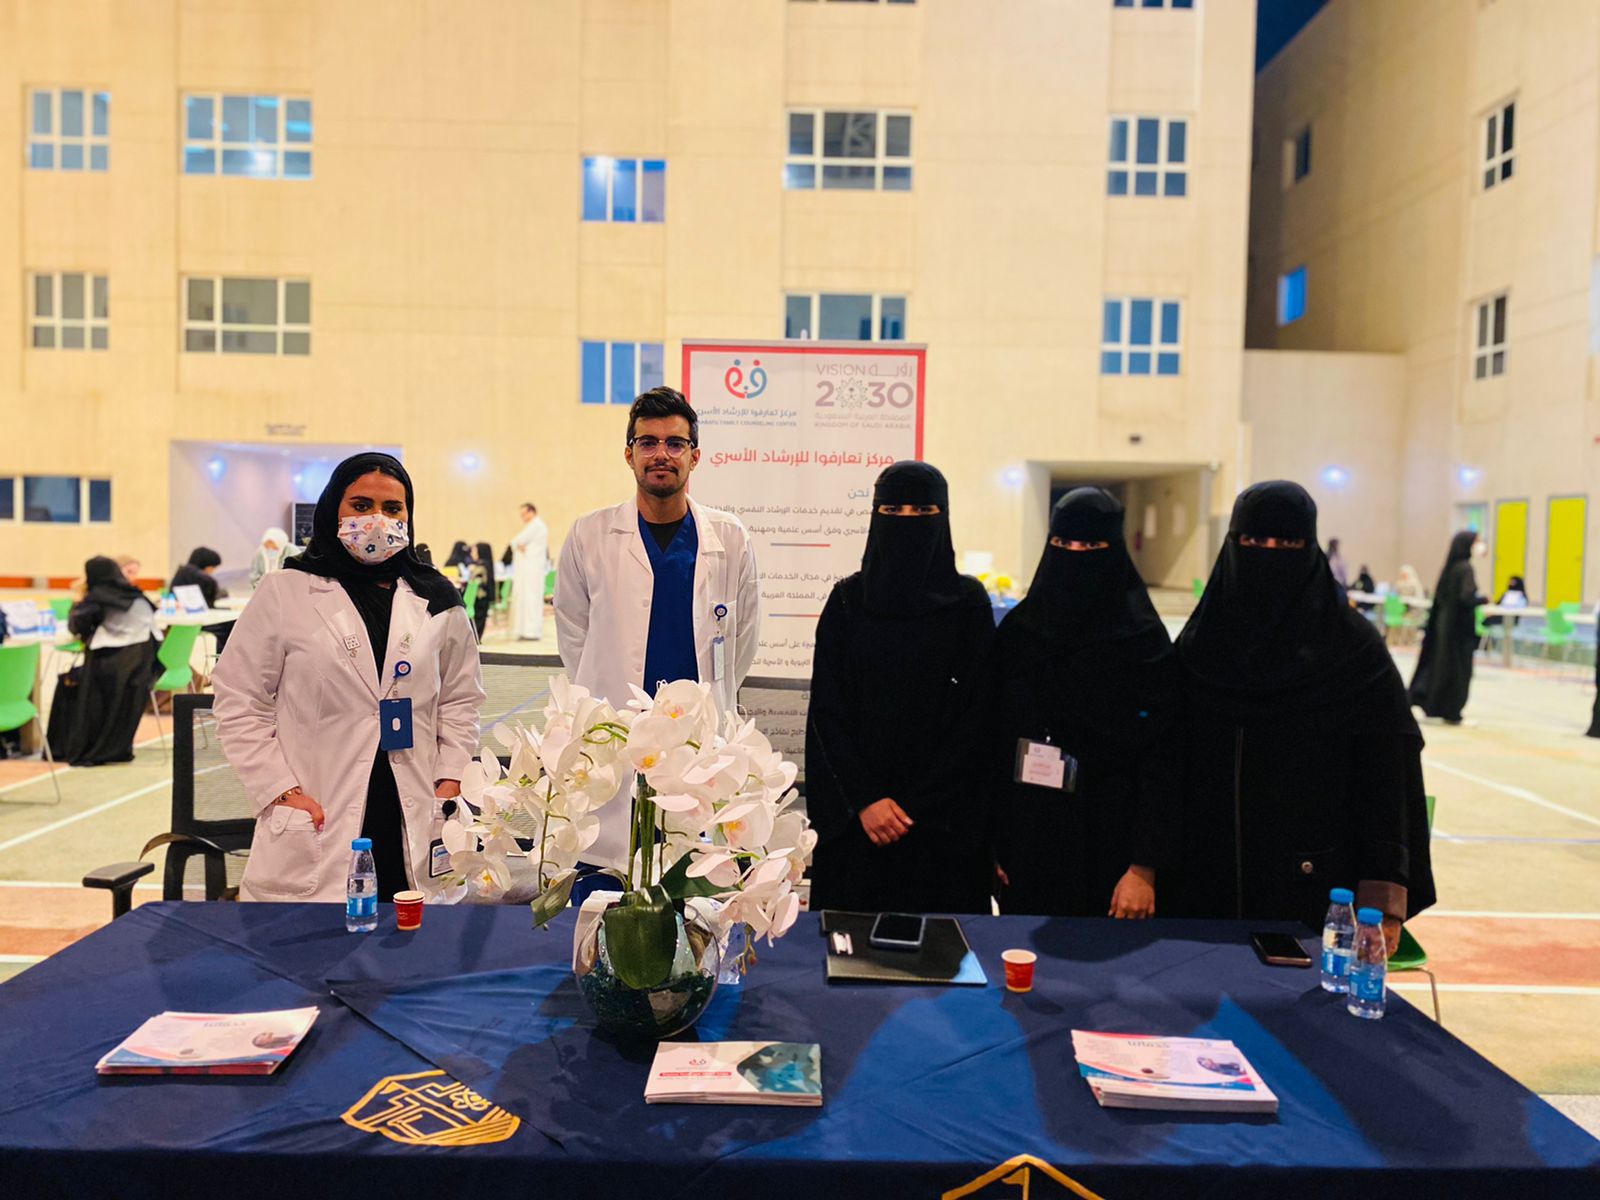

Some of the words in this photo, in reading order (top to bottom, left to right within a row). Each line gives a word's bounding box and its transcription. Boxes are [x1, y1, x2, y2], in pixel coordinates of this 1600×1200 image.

[815, 363, 866, 377] VISION
[710, 447, 757, 468] الأسري
[762, 449, 809, 467] للإرشاد
[814, 450, 862, 467] تعارفوا
[865, 452, 895, 468] مركز
[847, 488, 869, 500] نحن
